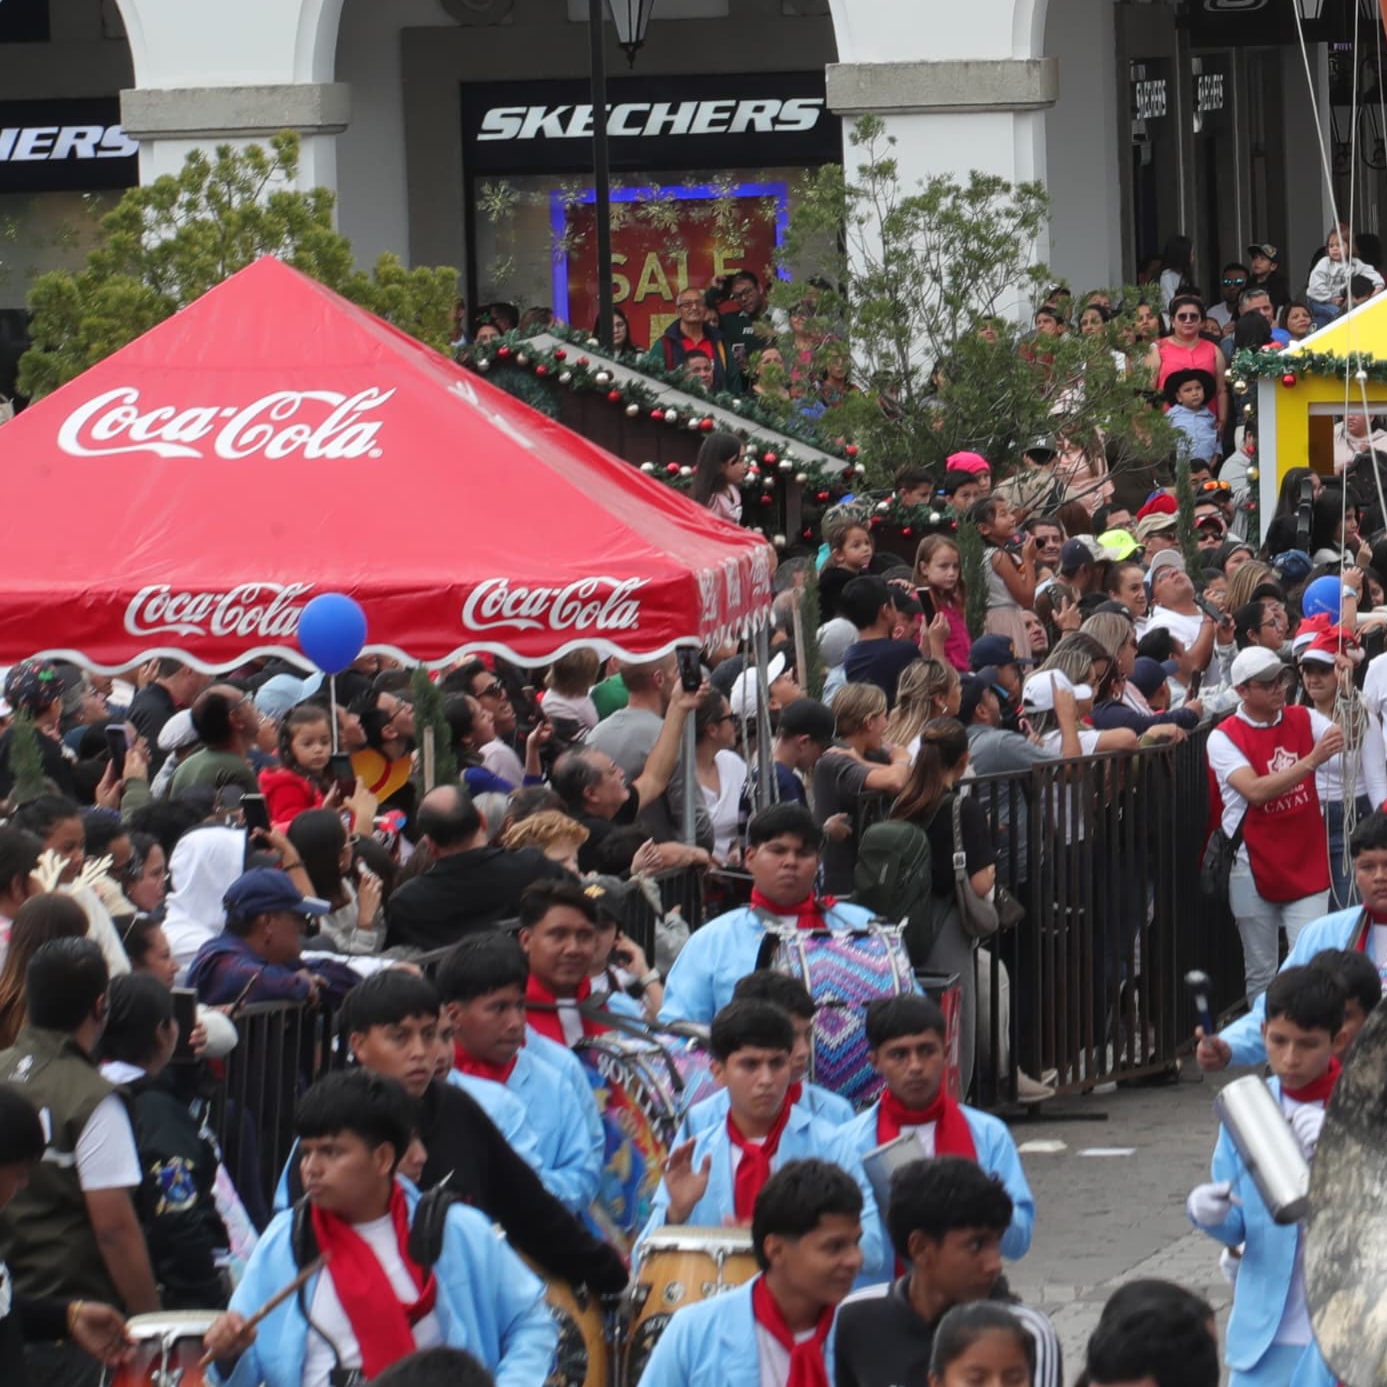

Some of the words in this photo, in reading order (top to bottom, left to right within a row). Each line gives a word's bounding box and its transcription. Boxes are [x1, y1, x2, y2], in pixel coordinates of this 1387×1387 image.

[476, 97, 825, 142] SKECHERS
[57, 386, 397, 459] Coca-Cola
[124, 581, 316, 637] Coca-Cola
[462, 575, 652, 631] Coca-Cola
